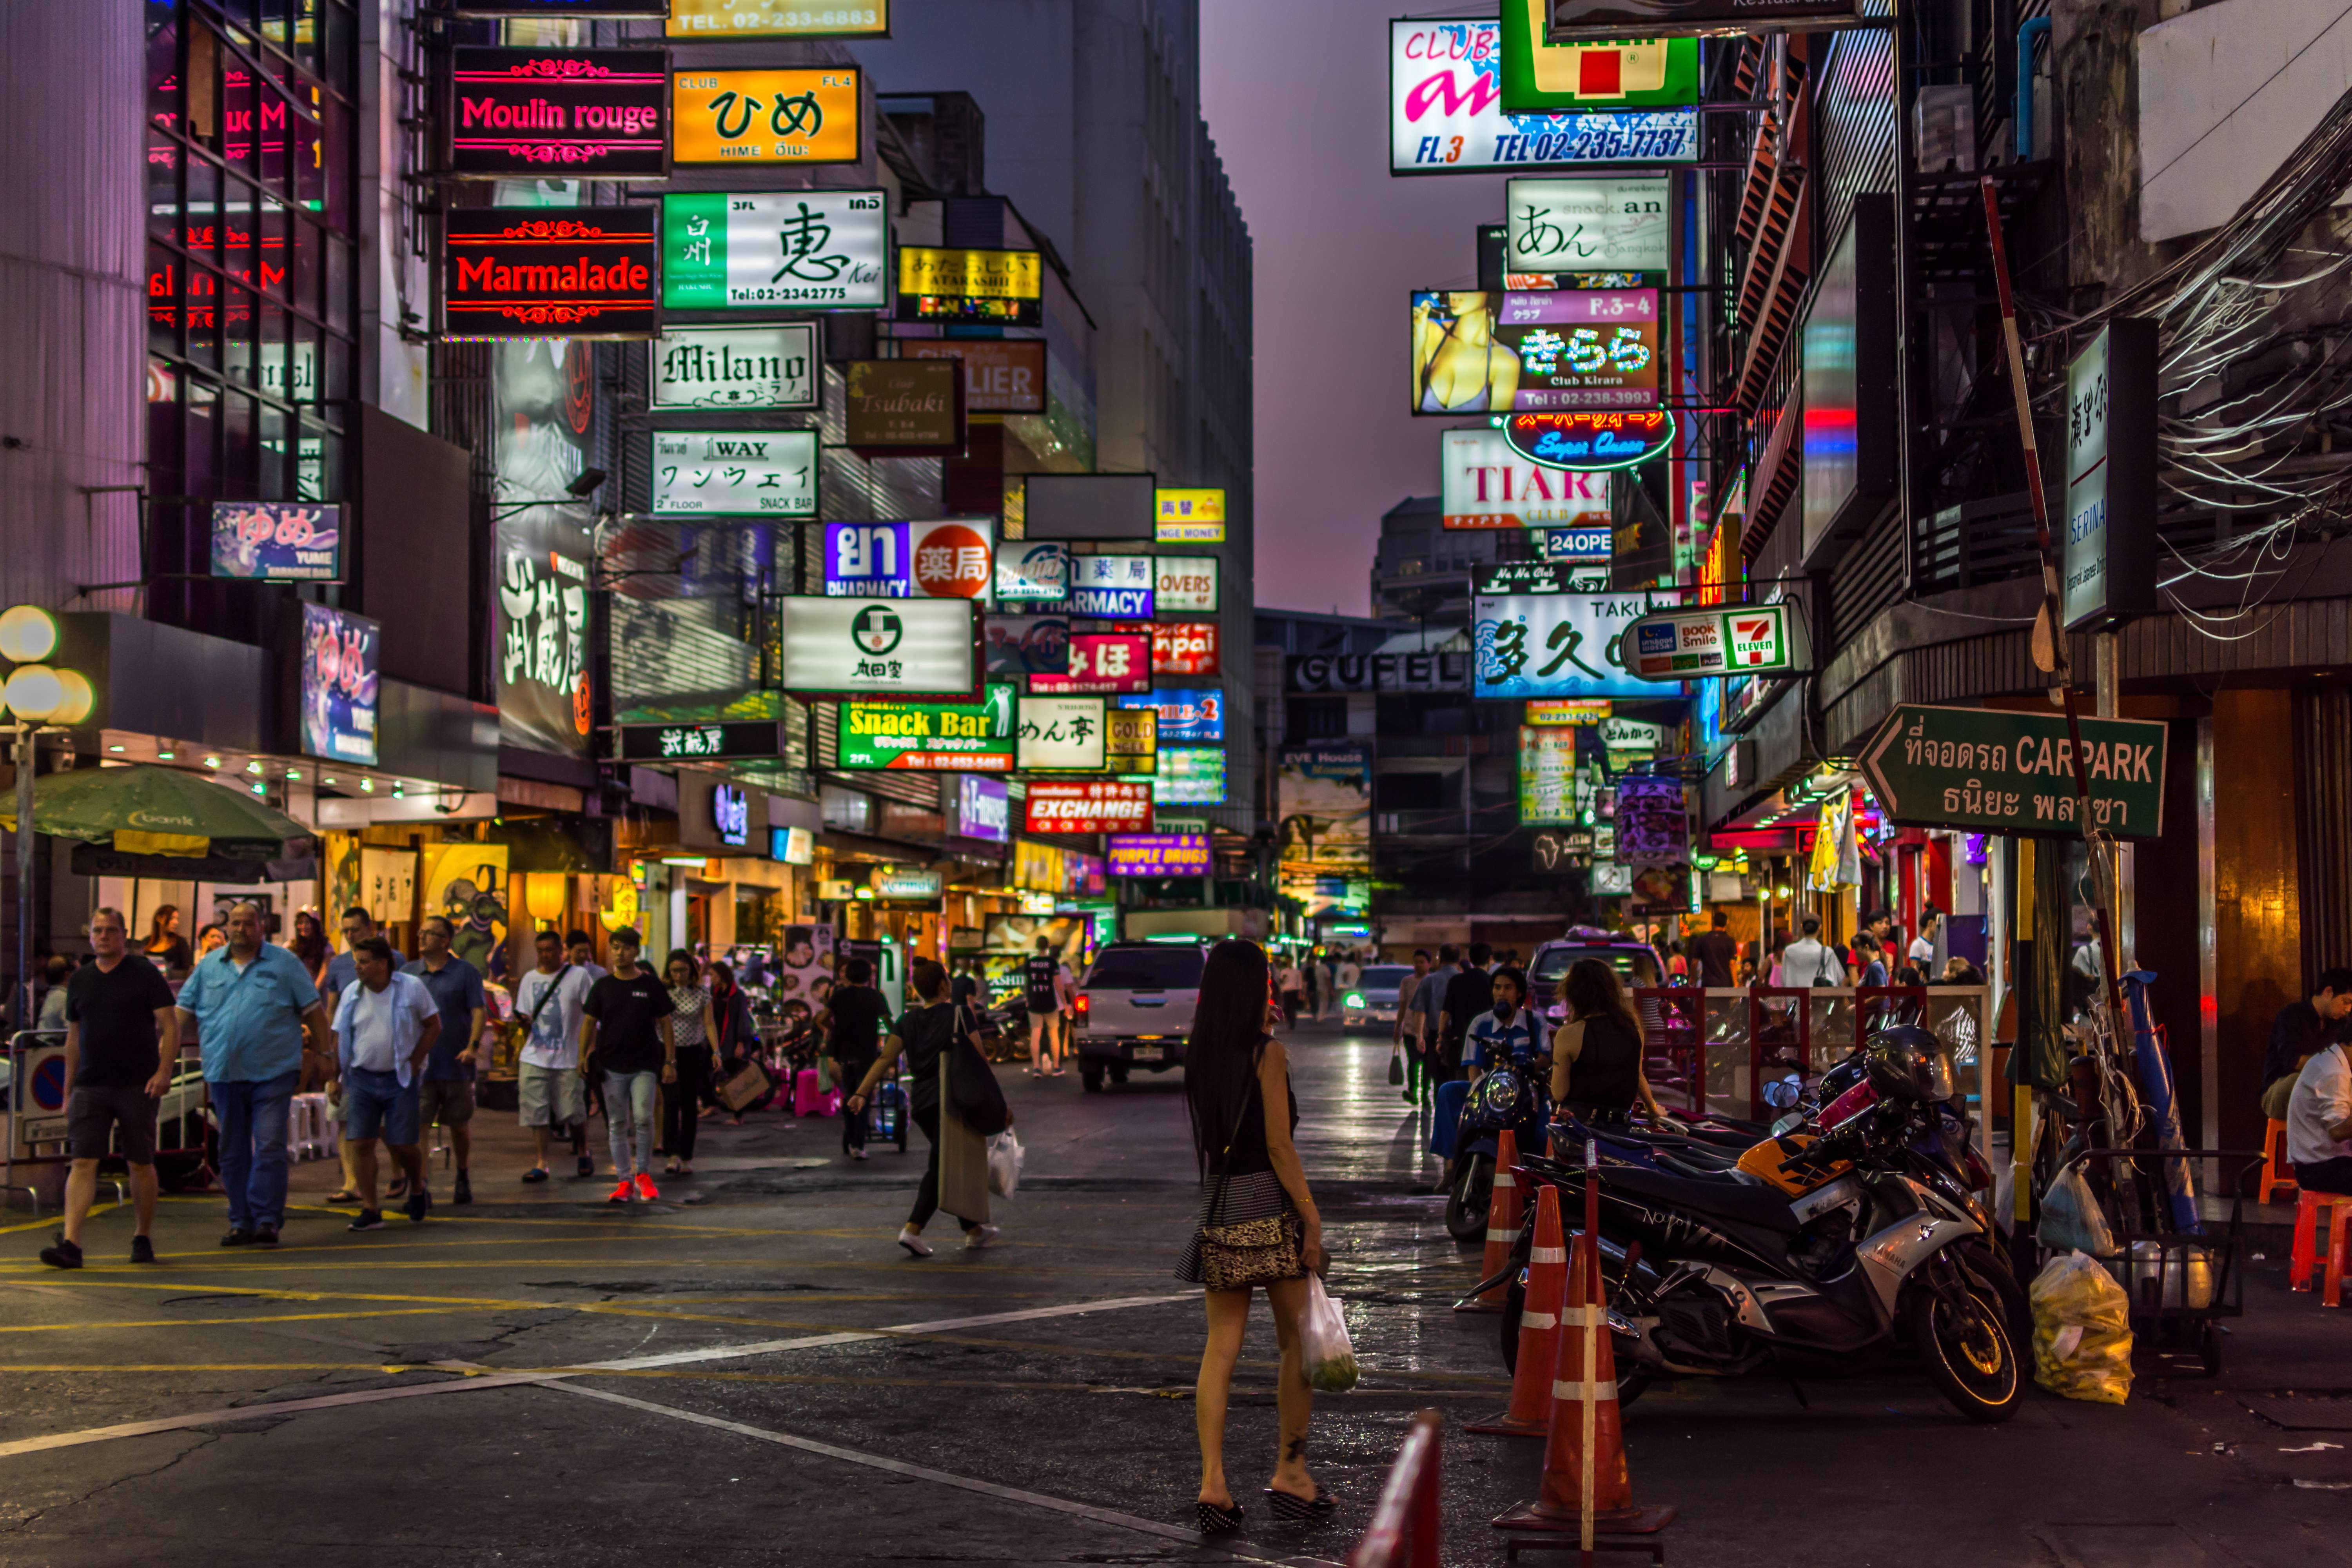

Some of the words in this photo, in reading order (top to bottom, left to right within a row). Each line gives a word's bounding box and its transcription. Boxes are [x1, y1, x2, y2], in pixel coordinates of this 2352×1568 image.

[678, 15, 728, 30] TEL.
[733, 9, 877, 28] 02-233-6883
[1405, 31, 1494, 61] CLUB
[679, 78, 718, 89] CLUB
[461, 97, 565, 128] Moulin
[574, 105, 657, 134] rouge
[708, 91, 823, 139] ひめ
[720, 145, 760, 156] HIME
[1416, 135, 1465, 163] FL.3
[1494, 134, 1531, 162] TEL
[1534, 129, 1687, 161] 02-235-7737
[732, 201, 755, 210] 3FL
[1517, 205, 1597, 256] あん
[683, 214, 710, 266] 白州
[1606, 241, 1666, 259] Bangkok
[456, 256, 648, 291] Marmalade
[848, 261, 880, 284] Kei
[1513, 309, 1541, 320] クラブ
[1519, 327, 1650, 375] きらら
[662, 344, 806, 383] Milano
[757, 380, 795, 394] ミラノ
[1551, 375, 1580, 385] Club
[1584, 375, 1623, 385] Kirara
[862, 393, 945, 414] Tsubaki
[1562, 391, 1651, 404] 02-238-3993
[716, 442, 768, 456] WAY
[1536, 431, 1588, 461] Super
[1595, 431, 1646, 454] Queen
[662, 466, 808, 488] ワンウェイ
[670, 501, 702, 509] FLOOR
[760, 497, 789, 509] SNACK
[795, 497, 812, 509] BAR
[1161, 501, 1192, 516] 両替
[1526, 509, 1568, 521] CLUB
[2071, 498, 2105, 546] SERINA
[237, 507, 314, 548] ゆめ
[1184, 528, 1220, 538] MONEY
[296, 551, 332, 564] YUME
[919, 546, 987, 581] 薬局
[1094, 559, 1146, 581] 薬局
[1533, 566, 1556, 577] Club
[827, 580, 906, 596] PHARMACY
[1160, 575, 1211, 593] OVERS
[2066, 566, 2082, 596] Teppanyaki
[2083, 563, 2096, 587] Japanese
[1682, 624, 1716, 636] BOOK
[1683, 635, 1718, 648] Smile
[850, 710, 931, 736] Snack
[940, 711, 991, 737] Bar
[1112, 721, 1155, 739] GOLD
[1606, 727, 1655, 740] とんかつ
[1904, 715, 2007, 772] ที่จอดรถ
[907, 756, 925, 767] Tel
[1285, 752, 1311, 764] EVE
[1318, 752, 1363, 763] House
[1944, 778, 2019, 816] ธนิยะ
[1031, 800, 1147, 819] EXCHANGE
[1109, 848, 1161, 864] PURPLE
[1163, 848, 1209, 864] DRUGS
[1872, 1243, 1906, 1269] YAMAHA
